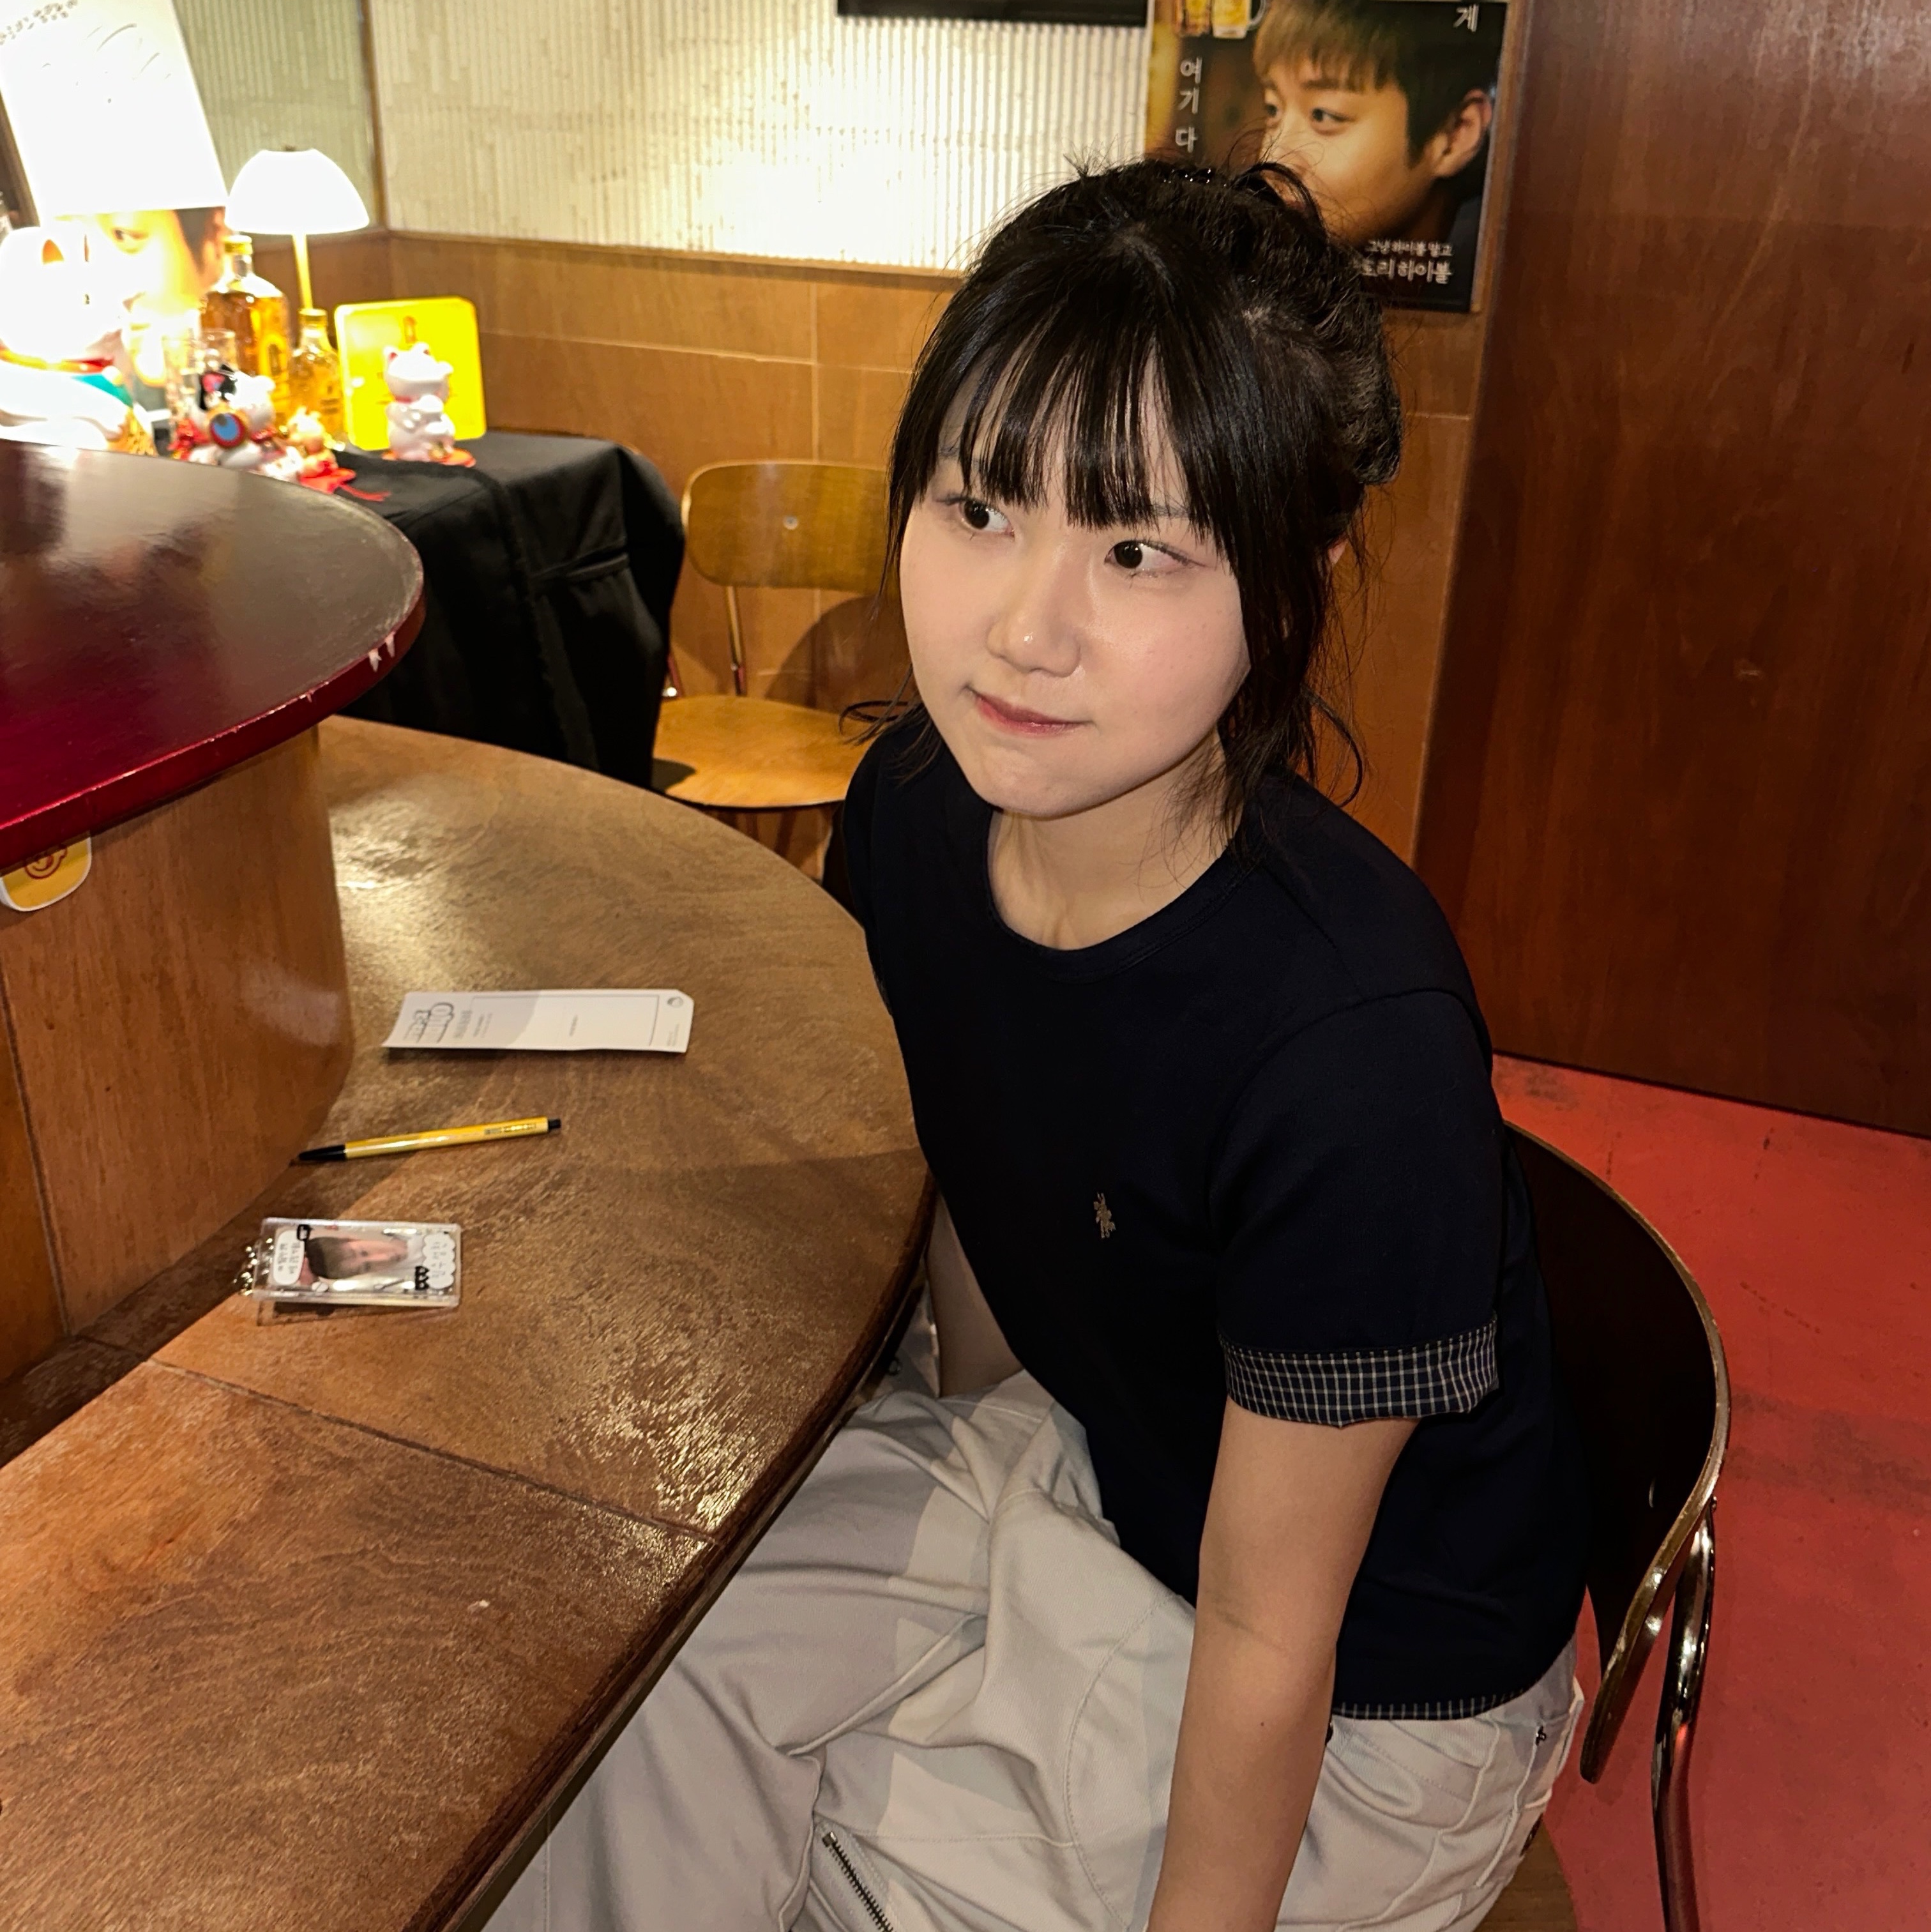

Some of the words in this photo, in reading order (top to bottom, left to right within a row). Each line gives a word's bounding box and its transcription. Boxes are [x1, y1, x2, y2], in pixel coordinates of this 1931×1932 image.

[1453, 4, 1480, 33] 게
[1178, 56, 1203, 115] 여기
[1352, 257, 1395, 280] 토리
[1397, 259, 1453, 285] 하이볼
